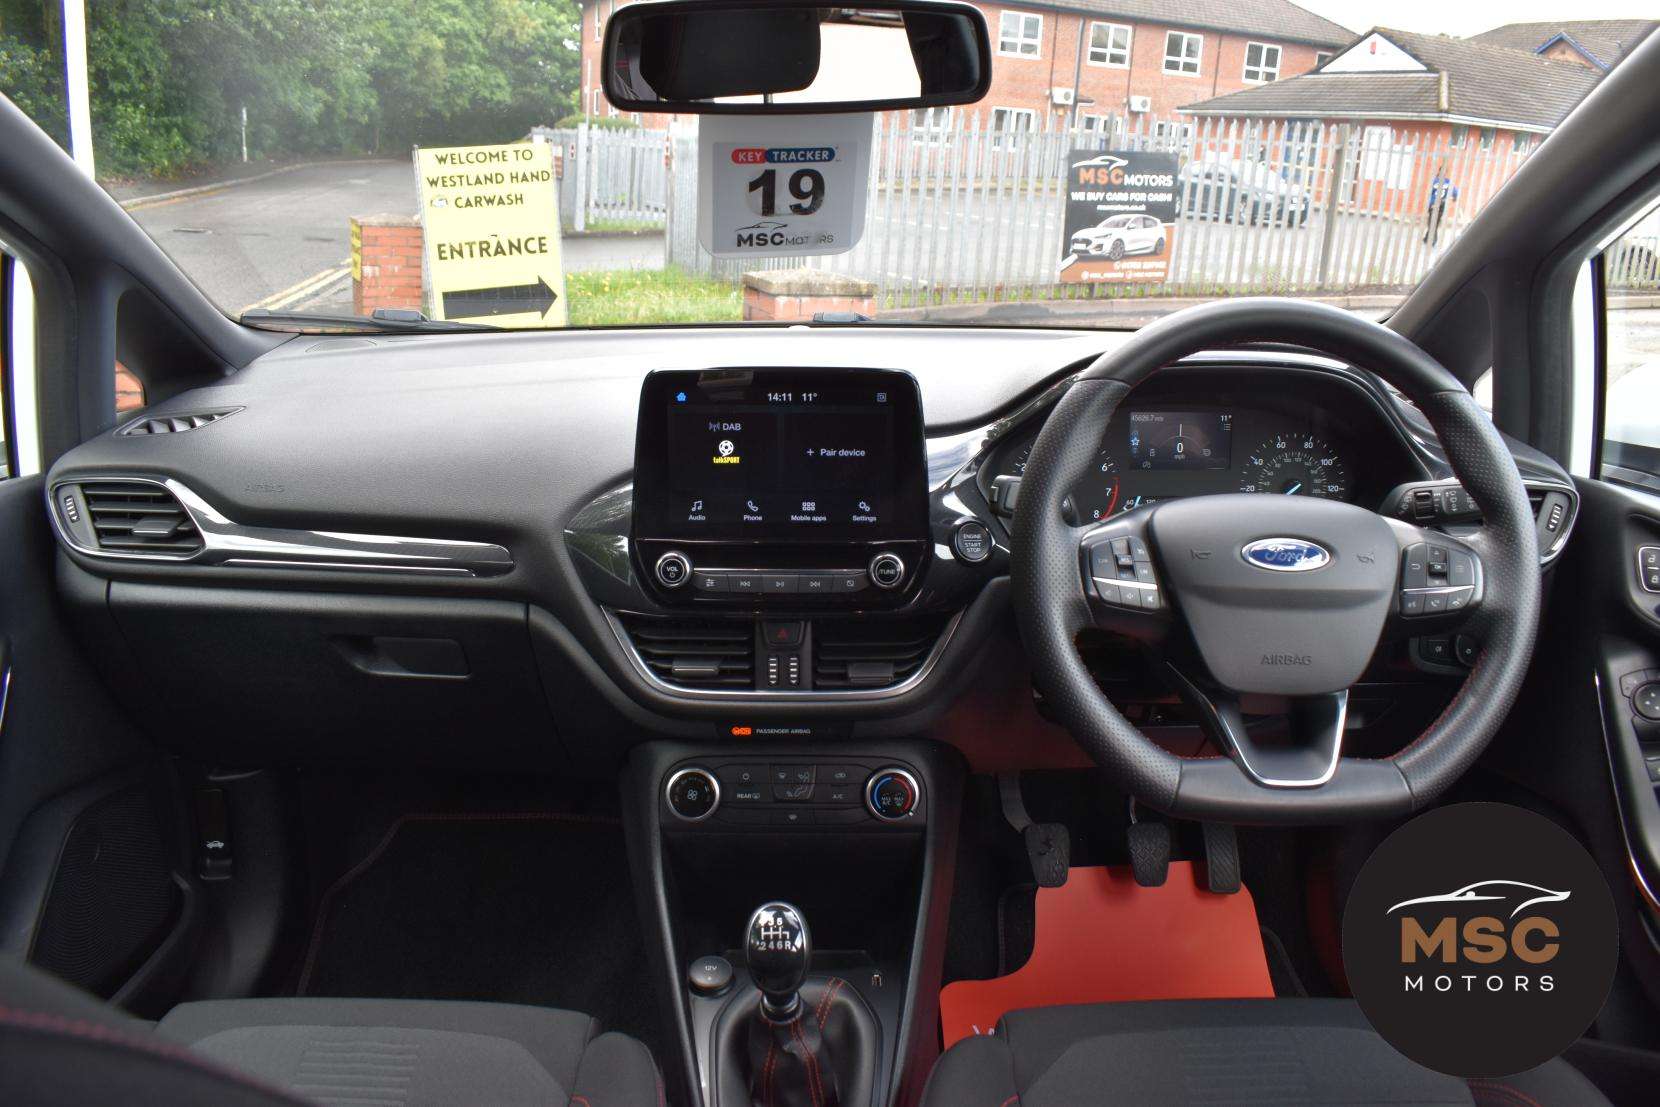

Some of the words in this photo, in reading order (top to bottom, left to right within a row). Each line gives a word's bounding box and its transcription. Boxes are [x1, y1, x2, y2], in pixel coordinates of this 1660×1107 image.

[435, 150, 509, 165] WELCOME
[514, 149, 533, 161] TO
[738, 151, 763, 162] KEY
[772, 150, 830, 162] TRACKER
[427, 172, 505, 188] WESTLAND
[510, 170, 550, 184] HAND
[1079, 168, 1124, 185] MSC
[1124, 174, 1174, 186] MOTORS
[749, 168, 826, 216] 19
[454, 194, 524, 208] CARWASH
[736, 232, 784, 247] MSC
[437, 236, 548, 260] ENTRANCE
[767, 393, 792, 402] 14:11
[802, 393, 818, 402] 11°
[722, 423, 742, 431] DAB
[840, 448, 866, 456] device
[1176, 442, 1184, 453] 0
[1101, 463, 1108, 472] 6
[1106, 488, 1112, 496] 7
[1093, 509, 1100, 519] 8
[1264, 547, 1307, 562] Ford
[1260, 654, 1312, 665] AIRBAG
[768, 941, 775, 950] 4
[776, 941, 783, 950] 6
[784, 941, 791, 950] R
